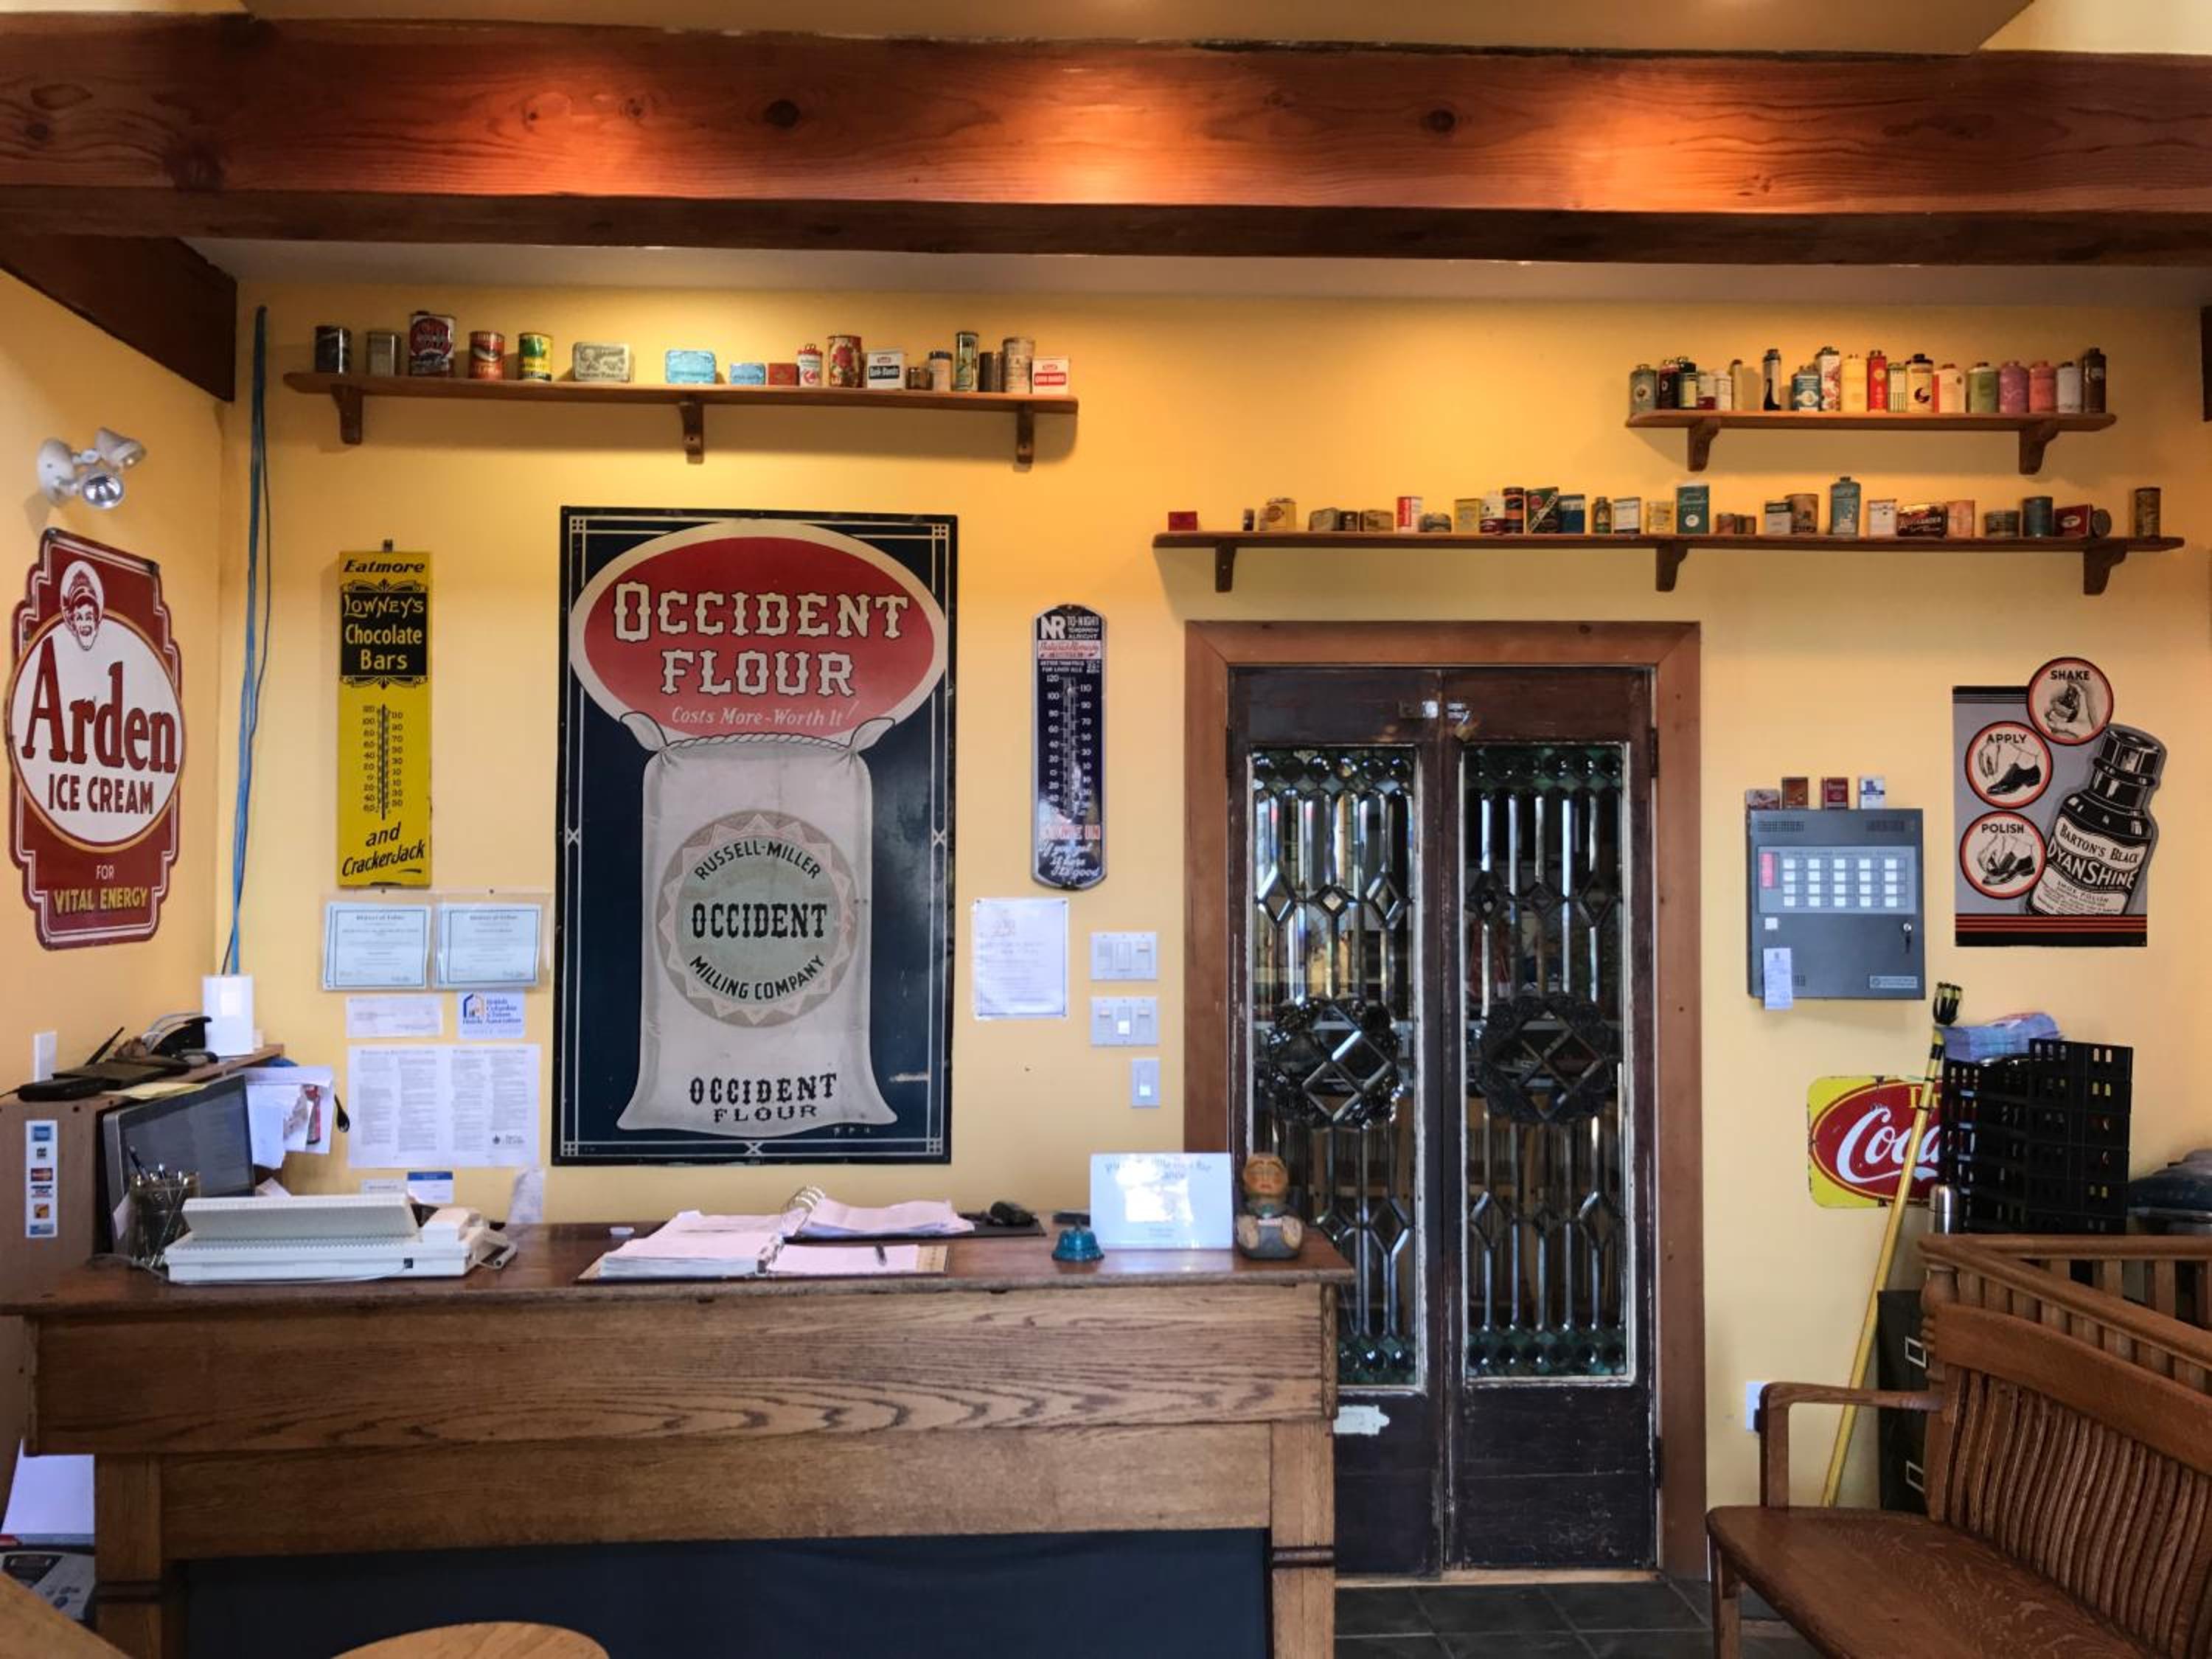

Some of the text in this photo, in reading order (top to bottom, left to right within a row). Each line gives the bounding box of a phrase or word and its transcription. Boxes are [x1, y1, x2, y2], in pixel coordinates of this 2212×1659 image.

[344, 560, 425, 574] Eatmore
[613, 580, 908, 643] OCCIDENT
[345, 623, 422, 645] Chocolate
[1040, 616, 1065, 639] NR
[360, 650, 408, 670] Bars
[661, 649, 855, 697] FLOUR
[2051, 669, 2090, 681] SHAKE
[21, 635, 177, 774] Arden
[672, 706, 715, 725] Costs
[1986, 733, 2027, 745] APPLY
[49, 776, 153, 815] ICE CREAM
[365, 821, 401, 847] and
[1981, 823, 2025, 834] POLISH
[2059, 824, 2138, 863] BARTON'S BLACK
[695, 838, 821, 880] RUSSELL-MILLER
[96, 864, 114, 881] FOR
[54, 887, 147, 914] VITAL ENERGY
[692, 902, 827, 939] OCCIDENT
[689, 954, 826, 1001] MILLING COMPANY
[689, 1073, 838, 1105] OCCIDENT
[713, 1105, 817, 1123] FLOUR
